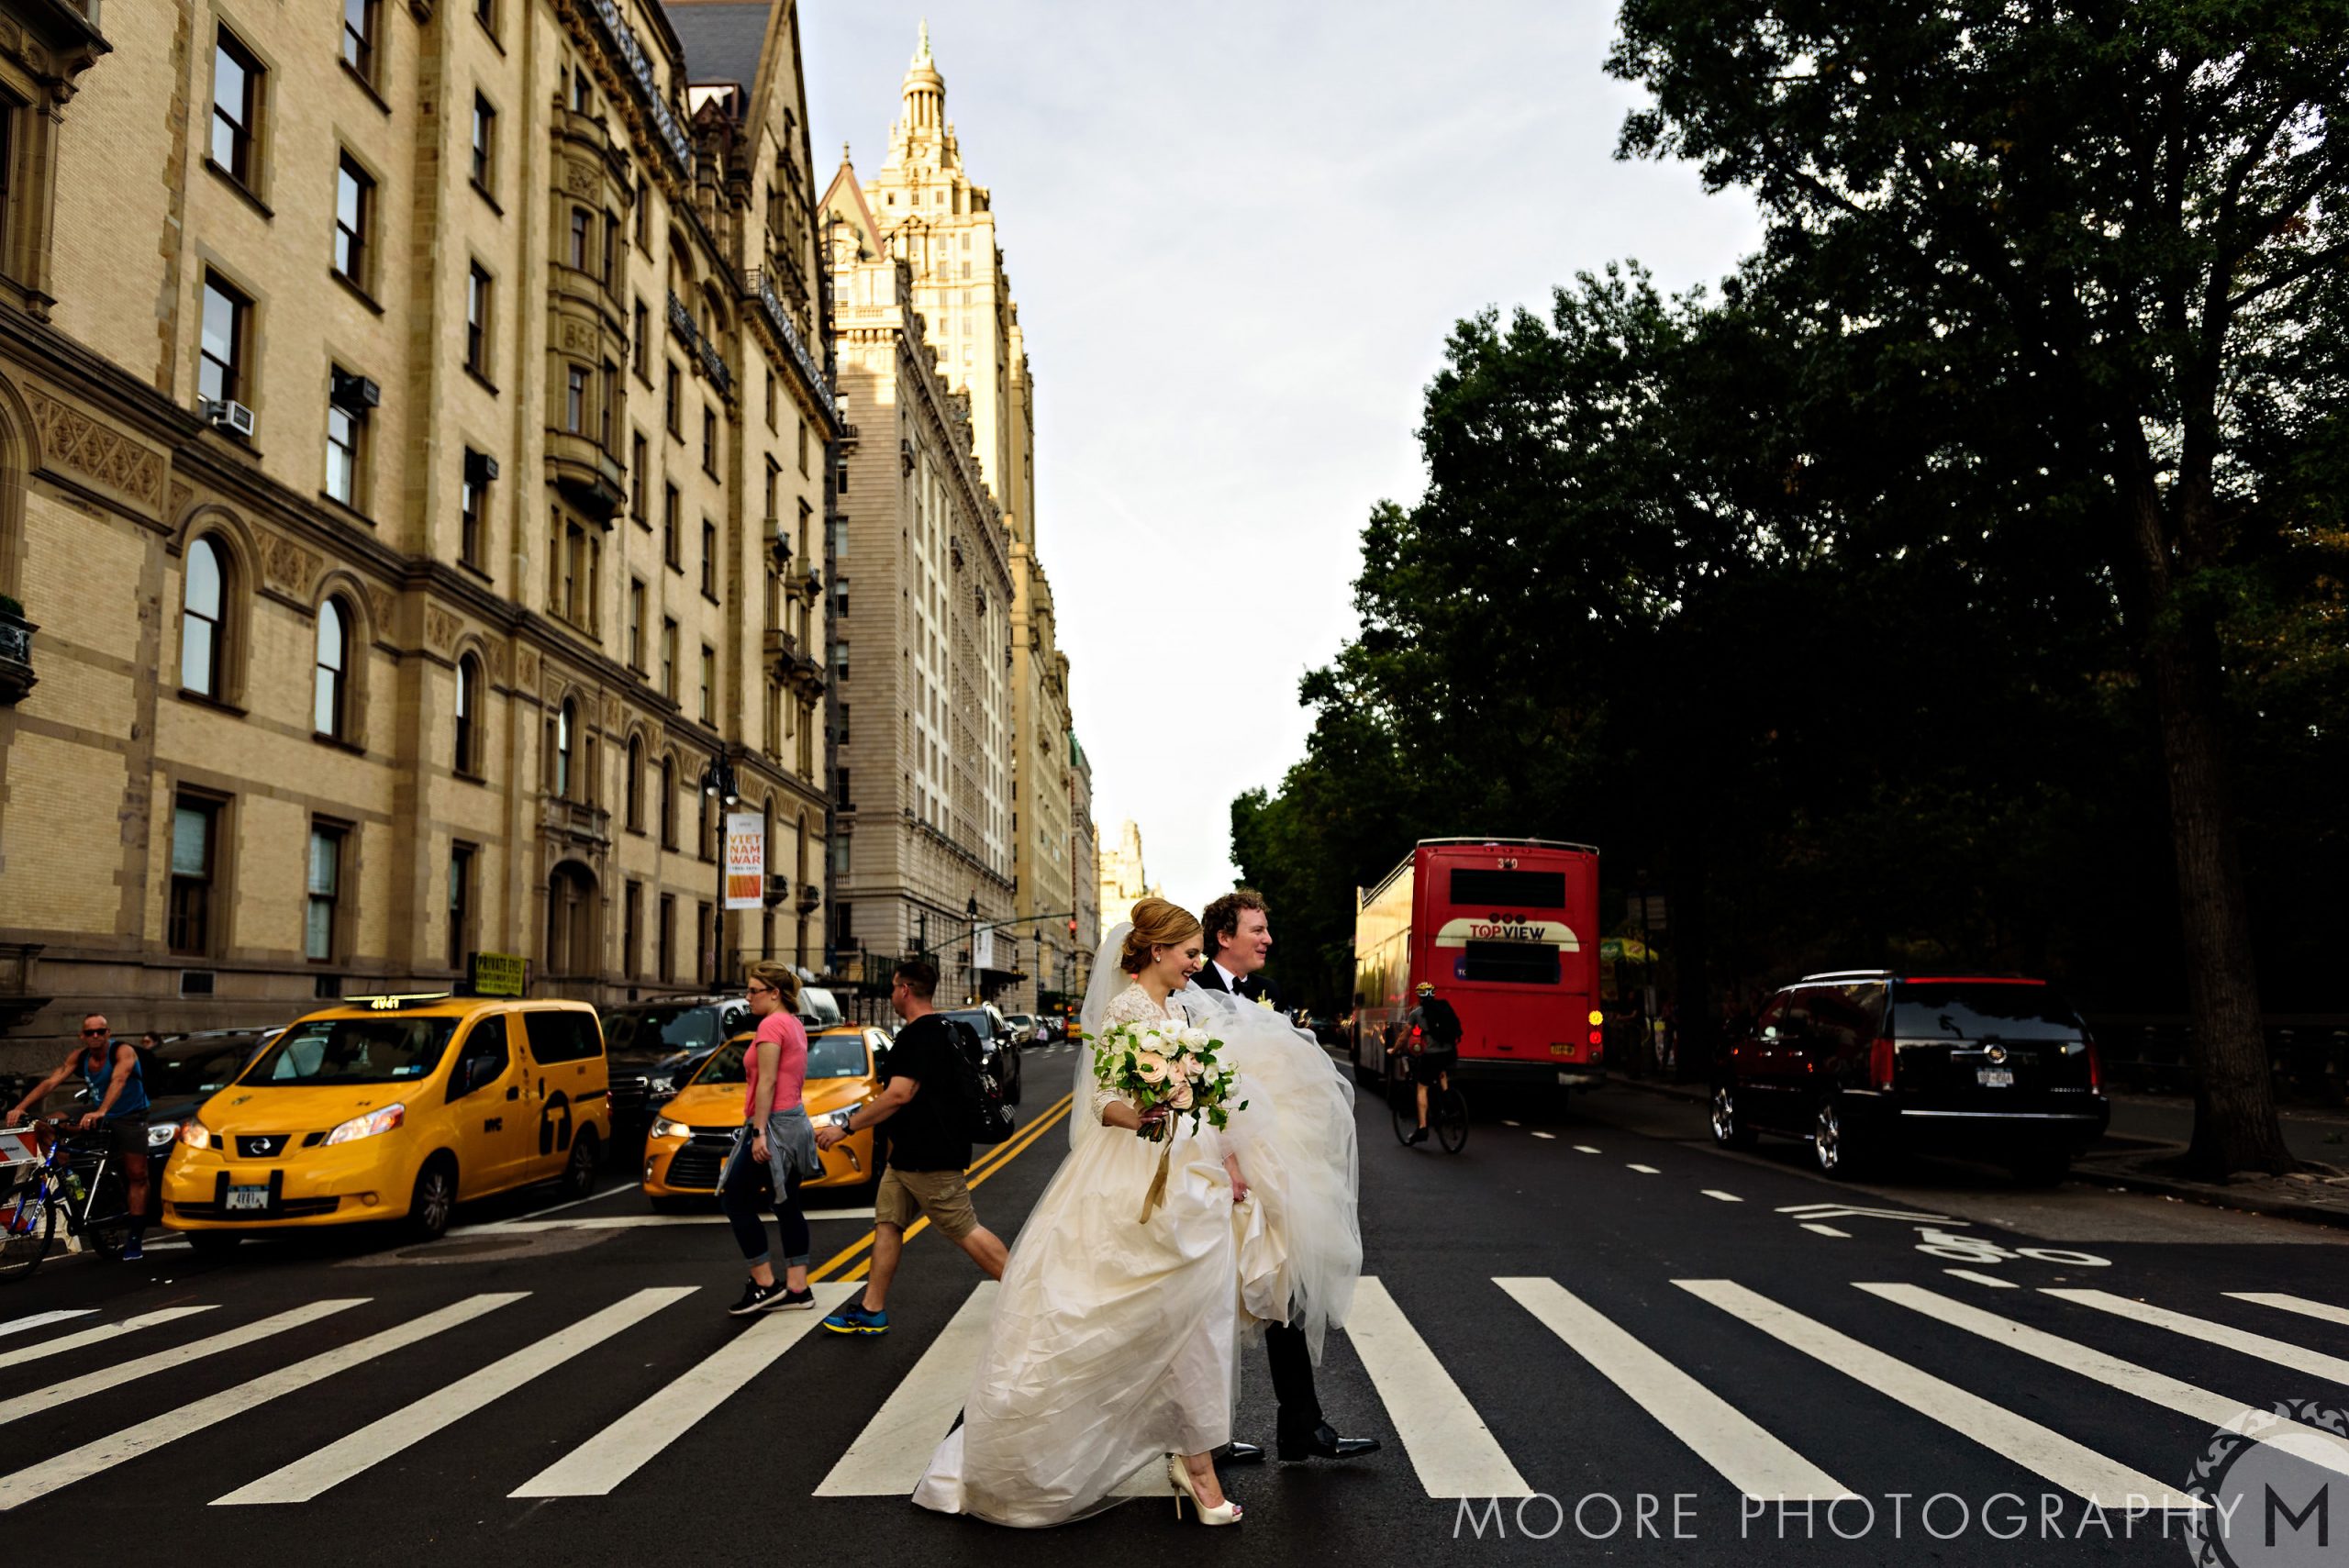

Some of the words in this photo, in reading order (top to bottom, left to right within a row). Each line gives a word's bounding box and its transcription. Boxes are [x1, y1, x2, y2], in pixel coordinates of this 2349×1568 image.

[729, 834, 761, 844] VIET
[729, 845, 761, 854] NAM
[729, 855, 761, 864] WAR
[1470, 924, 1545, 940] TOPVIEW
[478, 955, 507, 973] PRIVATE
[371, 998, 399, 1009] 4V41
[484, 1118, 502, 1132] NYC
